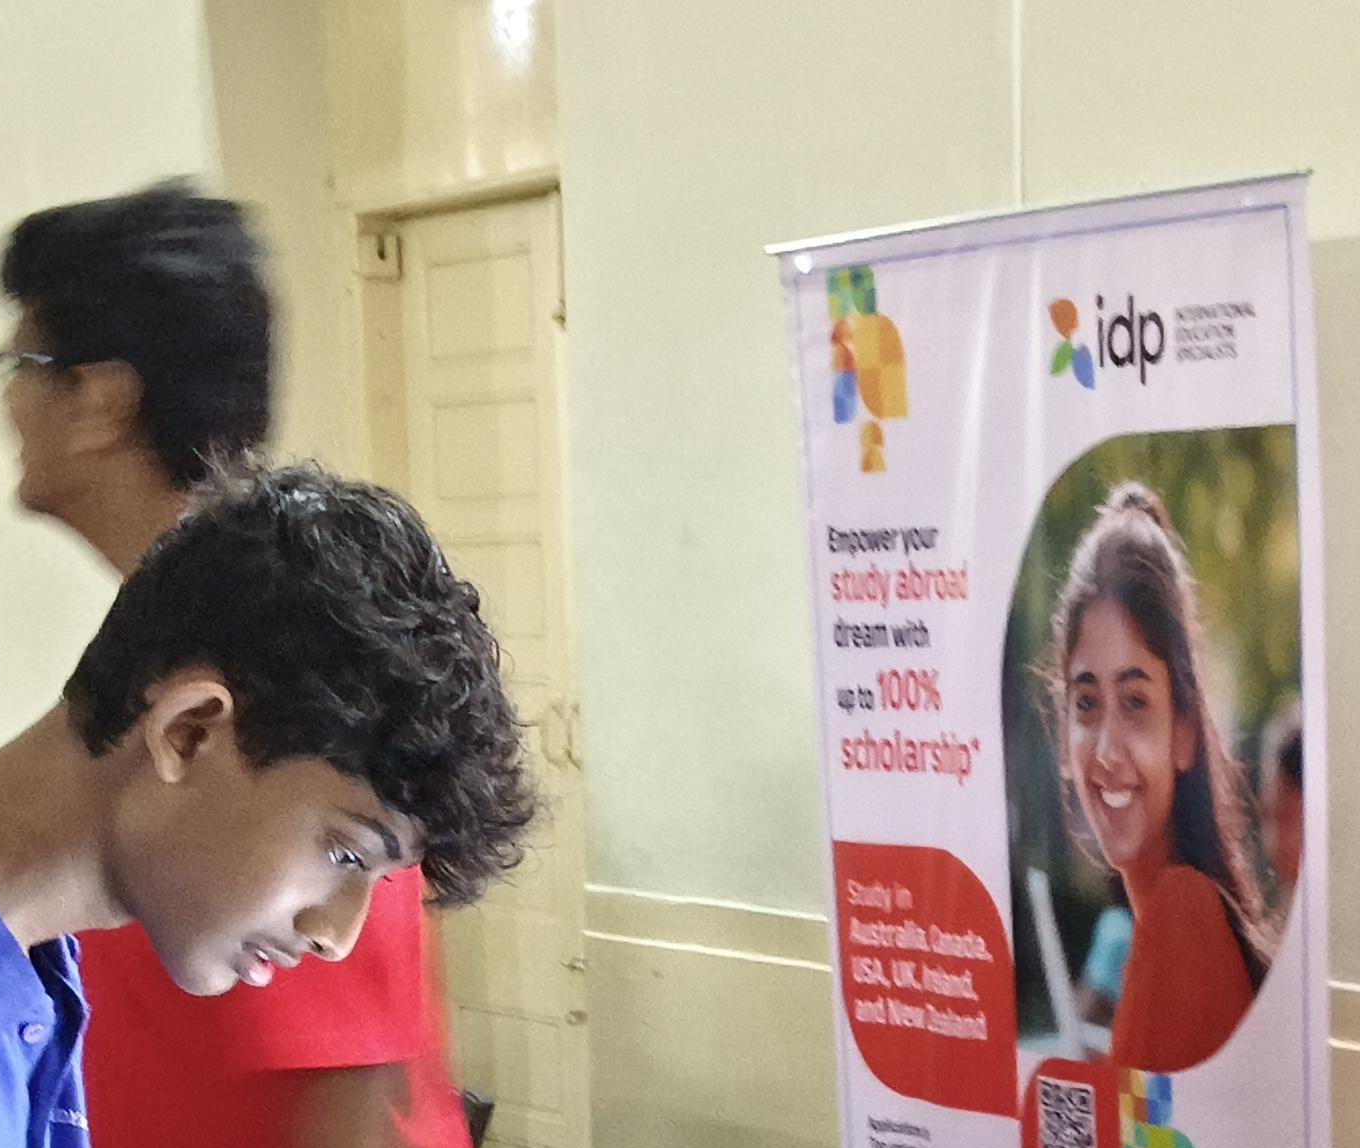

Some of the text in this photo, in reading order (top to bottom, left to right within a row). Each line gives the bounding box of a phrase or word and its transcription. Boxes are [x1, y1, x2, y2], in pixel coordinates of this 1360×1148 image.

[1096, 293, 1165, 386] idp
[828, 525, 938, 557] Empower your
[832, 560, 969, 608] study abroad
[833, 614, 930, 648] dream with
[877, 668, 943, 711] 100%
[848, 879, 892, 912] Study
[852, 957, 891, 988] USA,
[892, 959, 923, 990] UK,
[855, 995, 887, 1024] and
[887, 998, 926, 1028] New
